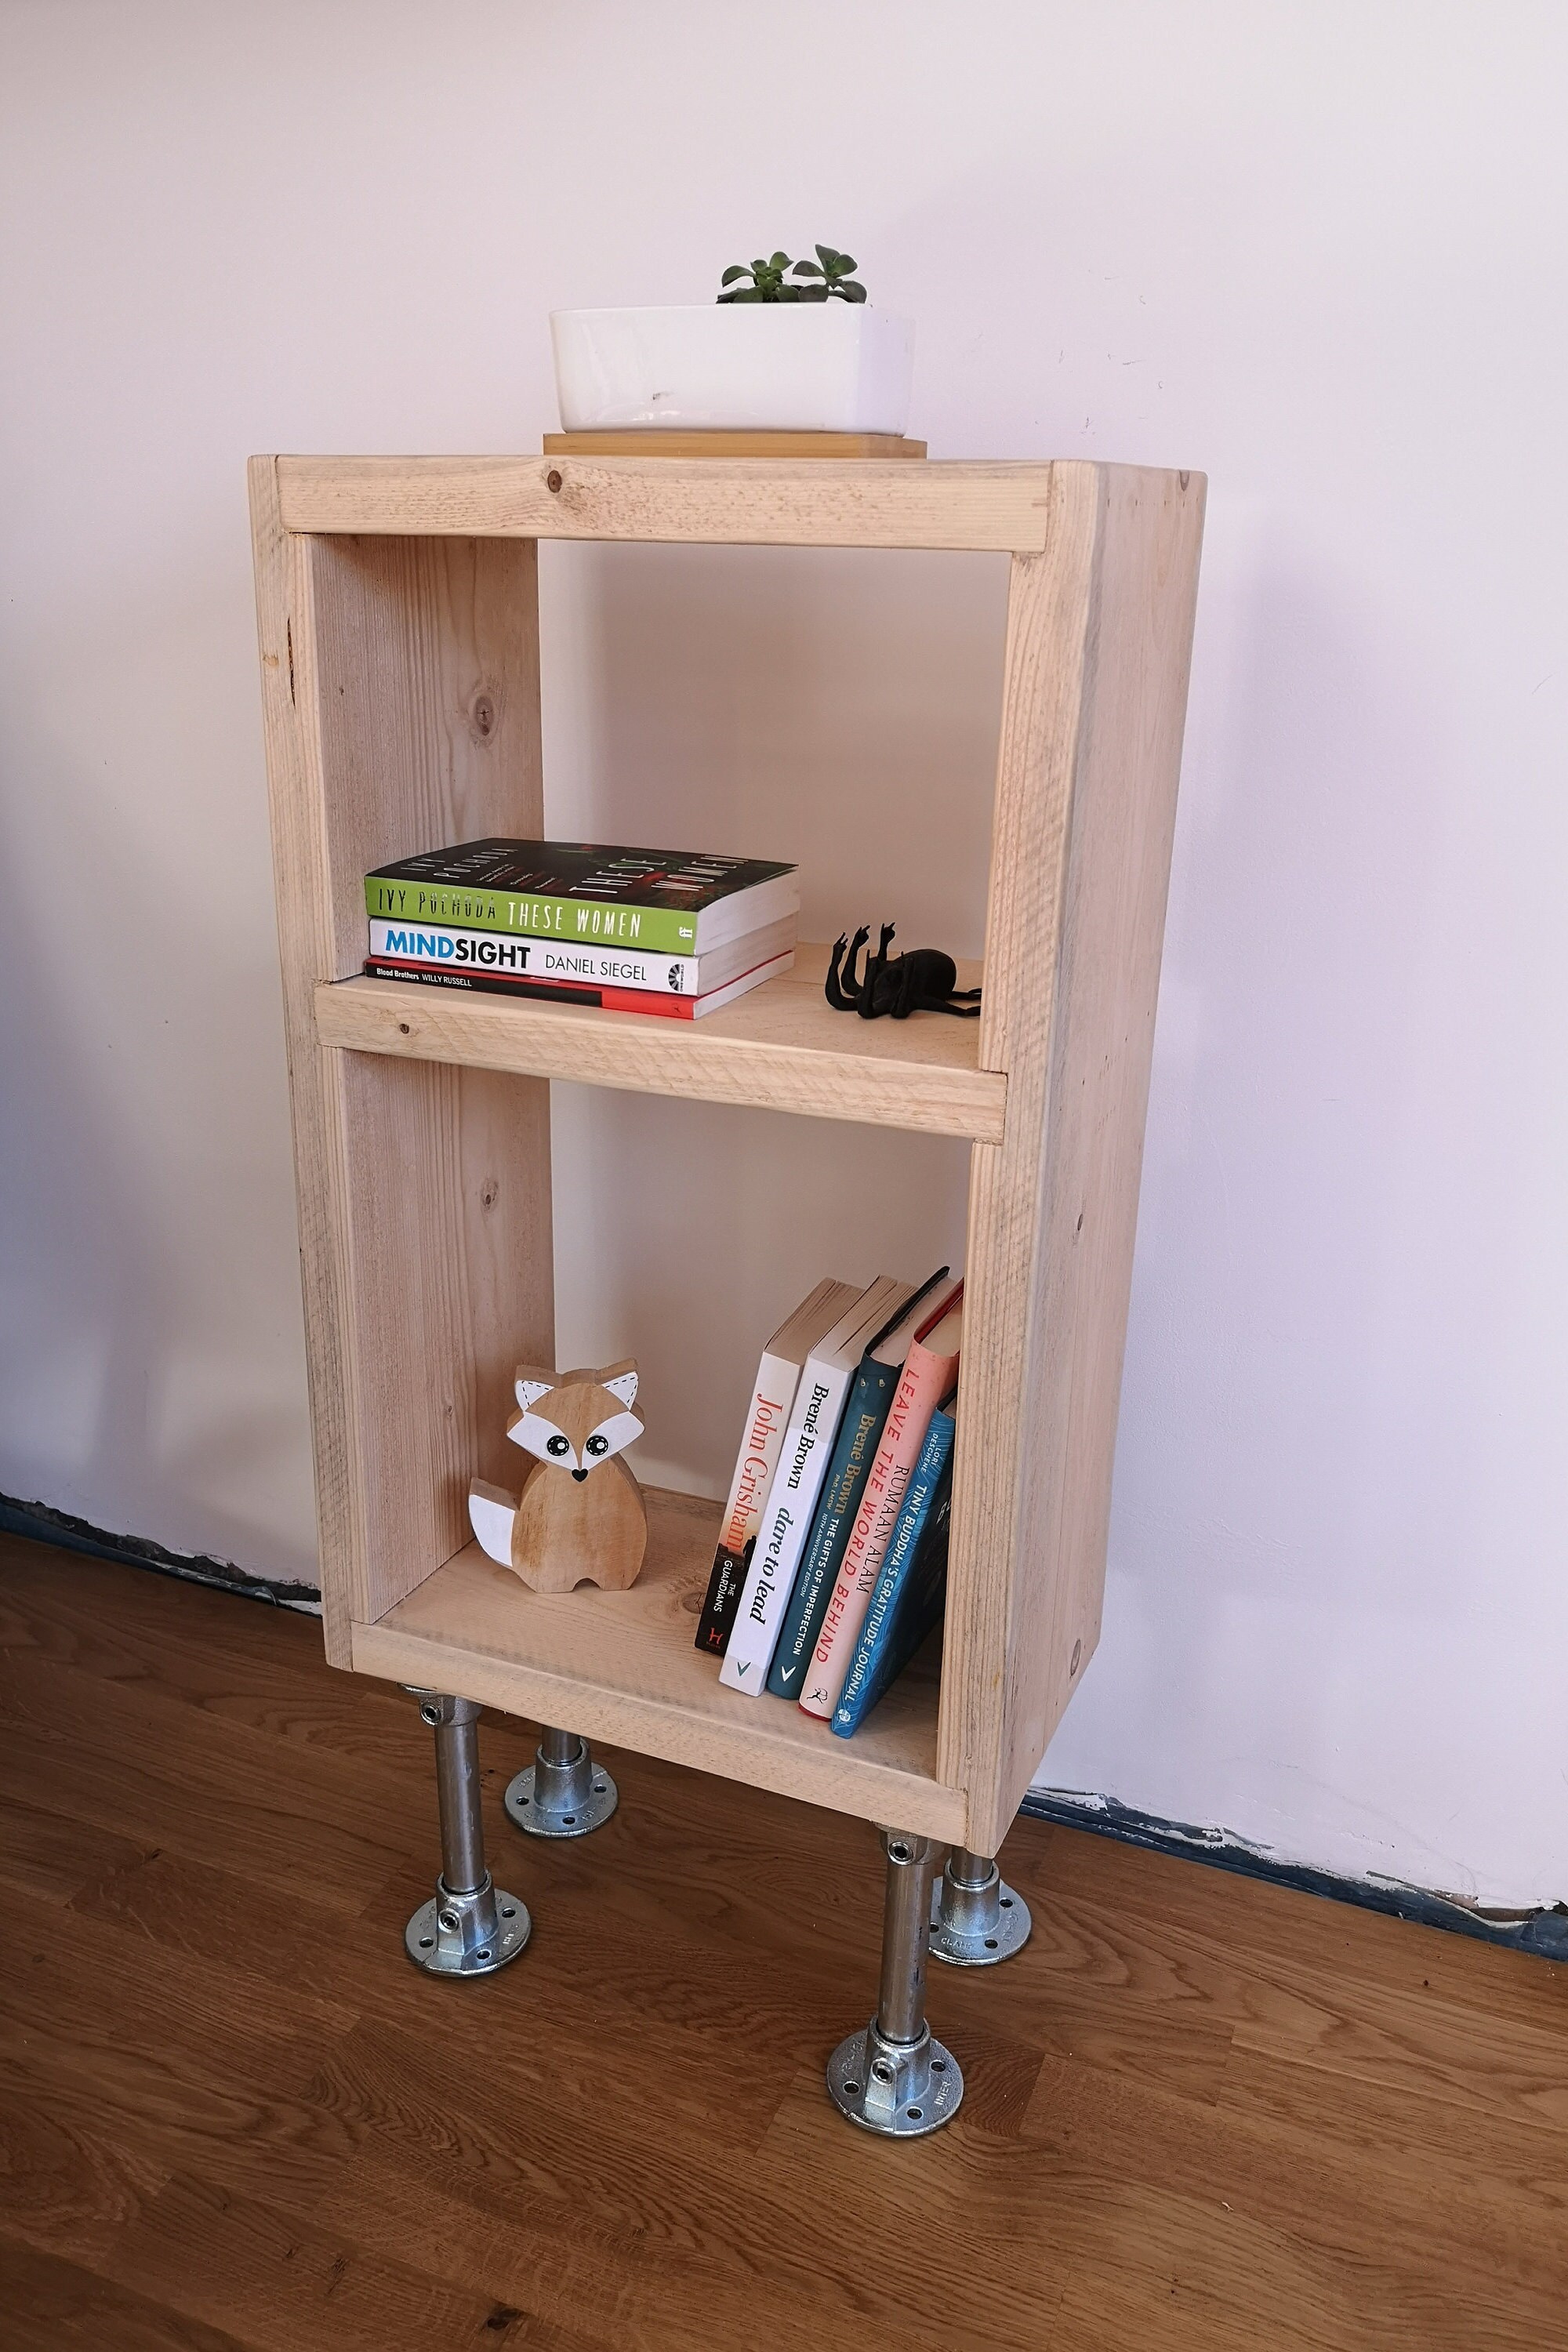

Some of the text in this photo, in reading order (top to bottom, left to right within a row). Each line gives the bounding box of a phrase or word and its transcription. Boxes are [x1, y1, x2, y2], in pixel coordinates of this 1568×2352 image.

[568, 855, 749, 894] THESE WOMEN
[379, 888, 641, 938] IVY POCHODA THESE WOMEN
[376, 967, 473, 987] Blood Brothers WILLY RUSSELL
[385, 930, 647, 982] MINDSIGHT DANIEL SIEGEL
[787, 1383, 830, 1490] Brené Brown
[834, 1414, 877, 1515] Brené Brown
[920, 1432, 938, 1473] DESCHENE
[931, 1446, 942, 1466] LORI
[726, 1392, 784, 1550] John Grisham
[909, 1484, 927, 1515] TINY
[816, 1368, 920, 1664] LEAVE THE WORLD BEHIND
[856, 1465, 910, 1594] RUMAAN ALAM
[749, 1507, 794, 1625] dare to lead
[800, 1513, 828, 1598] 10TH ANNIVERSARY EDITION
[887, 1515, 916, 1581] BUDDHA'S
[713, 1559, 733, 1613] GUARDIANS
[728, 1583, 736, 1596] THE
[792, 1518, 840, 1656] THE GIFTS OF IMPERFECTION
[863, 1578, 894, 1647] GRATITUDE
[844, 1647, 870, 1701] JOURNAL
